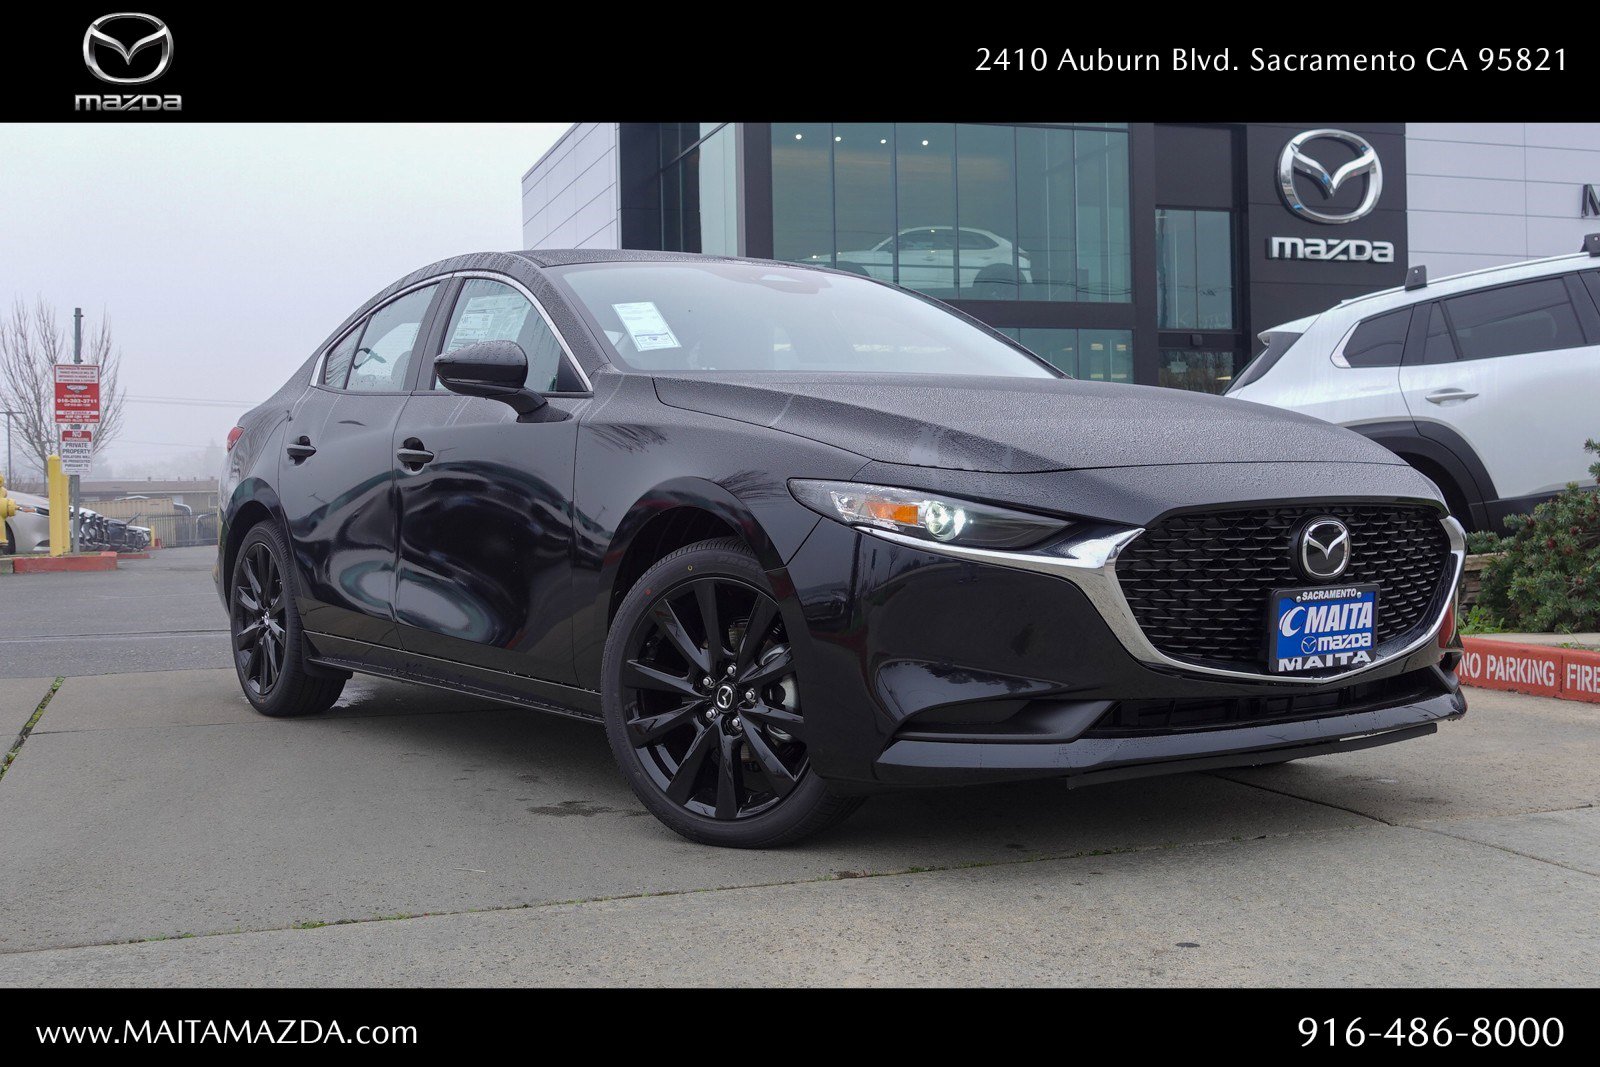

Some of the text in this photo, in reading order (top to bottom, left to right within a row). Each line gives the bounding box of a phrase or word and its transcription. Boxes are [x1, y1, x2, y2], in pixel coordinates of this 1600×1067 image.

[1270, 236, 1395, 263] mazda
[72, 430, 82, 438] NO
[1301, 588, 1357, 601] SACRAMENTO
[1304, 601, 1373, 634] MAITA
[1317, 632, 1372, 652] mazda
[1278, 650, 1372, 672] MAITA
[1459, 652, 1600, 694] NO PARKING FIRE
